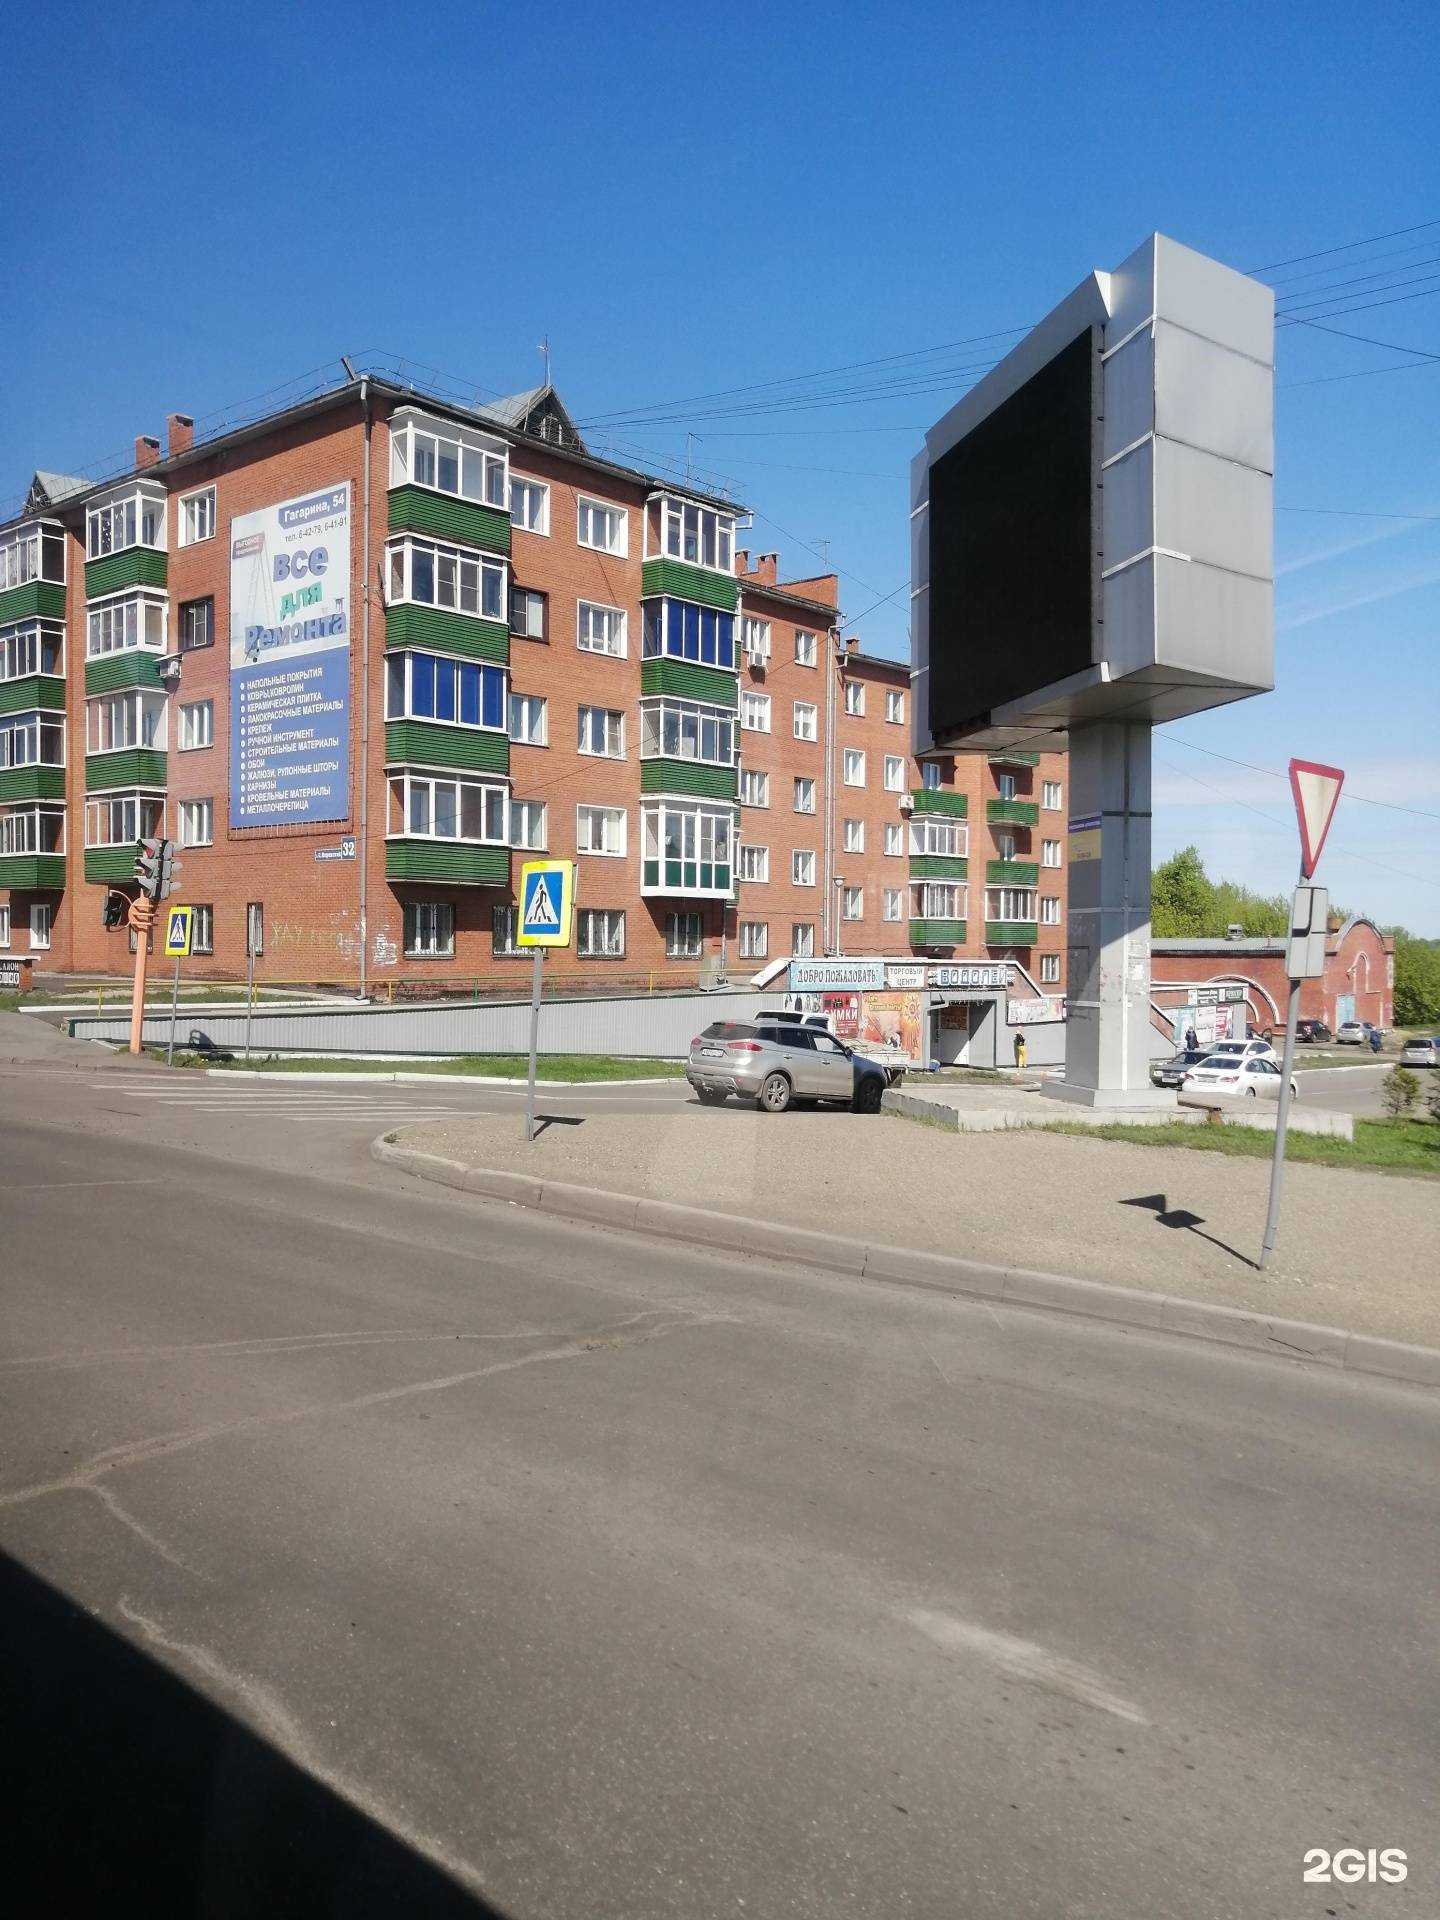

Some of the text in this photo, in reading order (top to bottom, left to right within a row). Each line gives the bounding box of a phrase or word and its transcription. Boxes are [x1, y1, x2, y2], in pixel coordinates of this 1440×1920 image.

[285, 493, 345, 522] Гагарина, 54
[245, 612, 347, 654] Ремонта
[247, 667, 323, 690] НАПОЛЬНЫЕ ПОКРЫТИЯ
[247, 692, 322, 713] КЕРАМИЧЕСКАЯ ПЛИТКА
[247, 700, 344, 724] ЛАКОКРАСОЧНЫЕ МАТЕРИАЛЫ
[273, 729, 314, 743] ИНСТРУМЕНТ
[247, 737, 339, 758] СТРОИТЕЛЬНЫЕ МАТЕРИАЛЫ
[277, 764, 312, 776] РУЛОННЫЕ
[313, 761, 339, 773] ШТОРЫ
[247, 785, 331, 803] КРОВЕЛЬНЫЕ МАТЕРИАЛЫ
[247, 800, 309, 814] МЕТАЛЛОЧЕРЕПИЦА
[342, 842, 355, 857] 32
[797, 969, 824, 983] ДОБРО
[897, 978, 917, 987] ЦЕНТР
[940, 967, 1007, 985] ВОДОЛЕЙ
